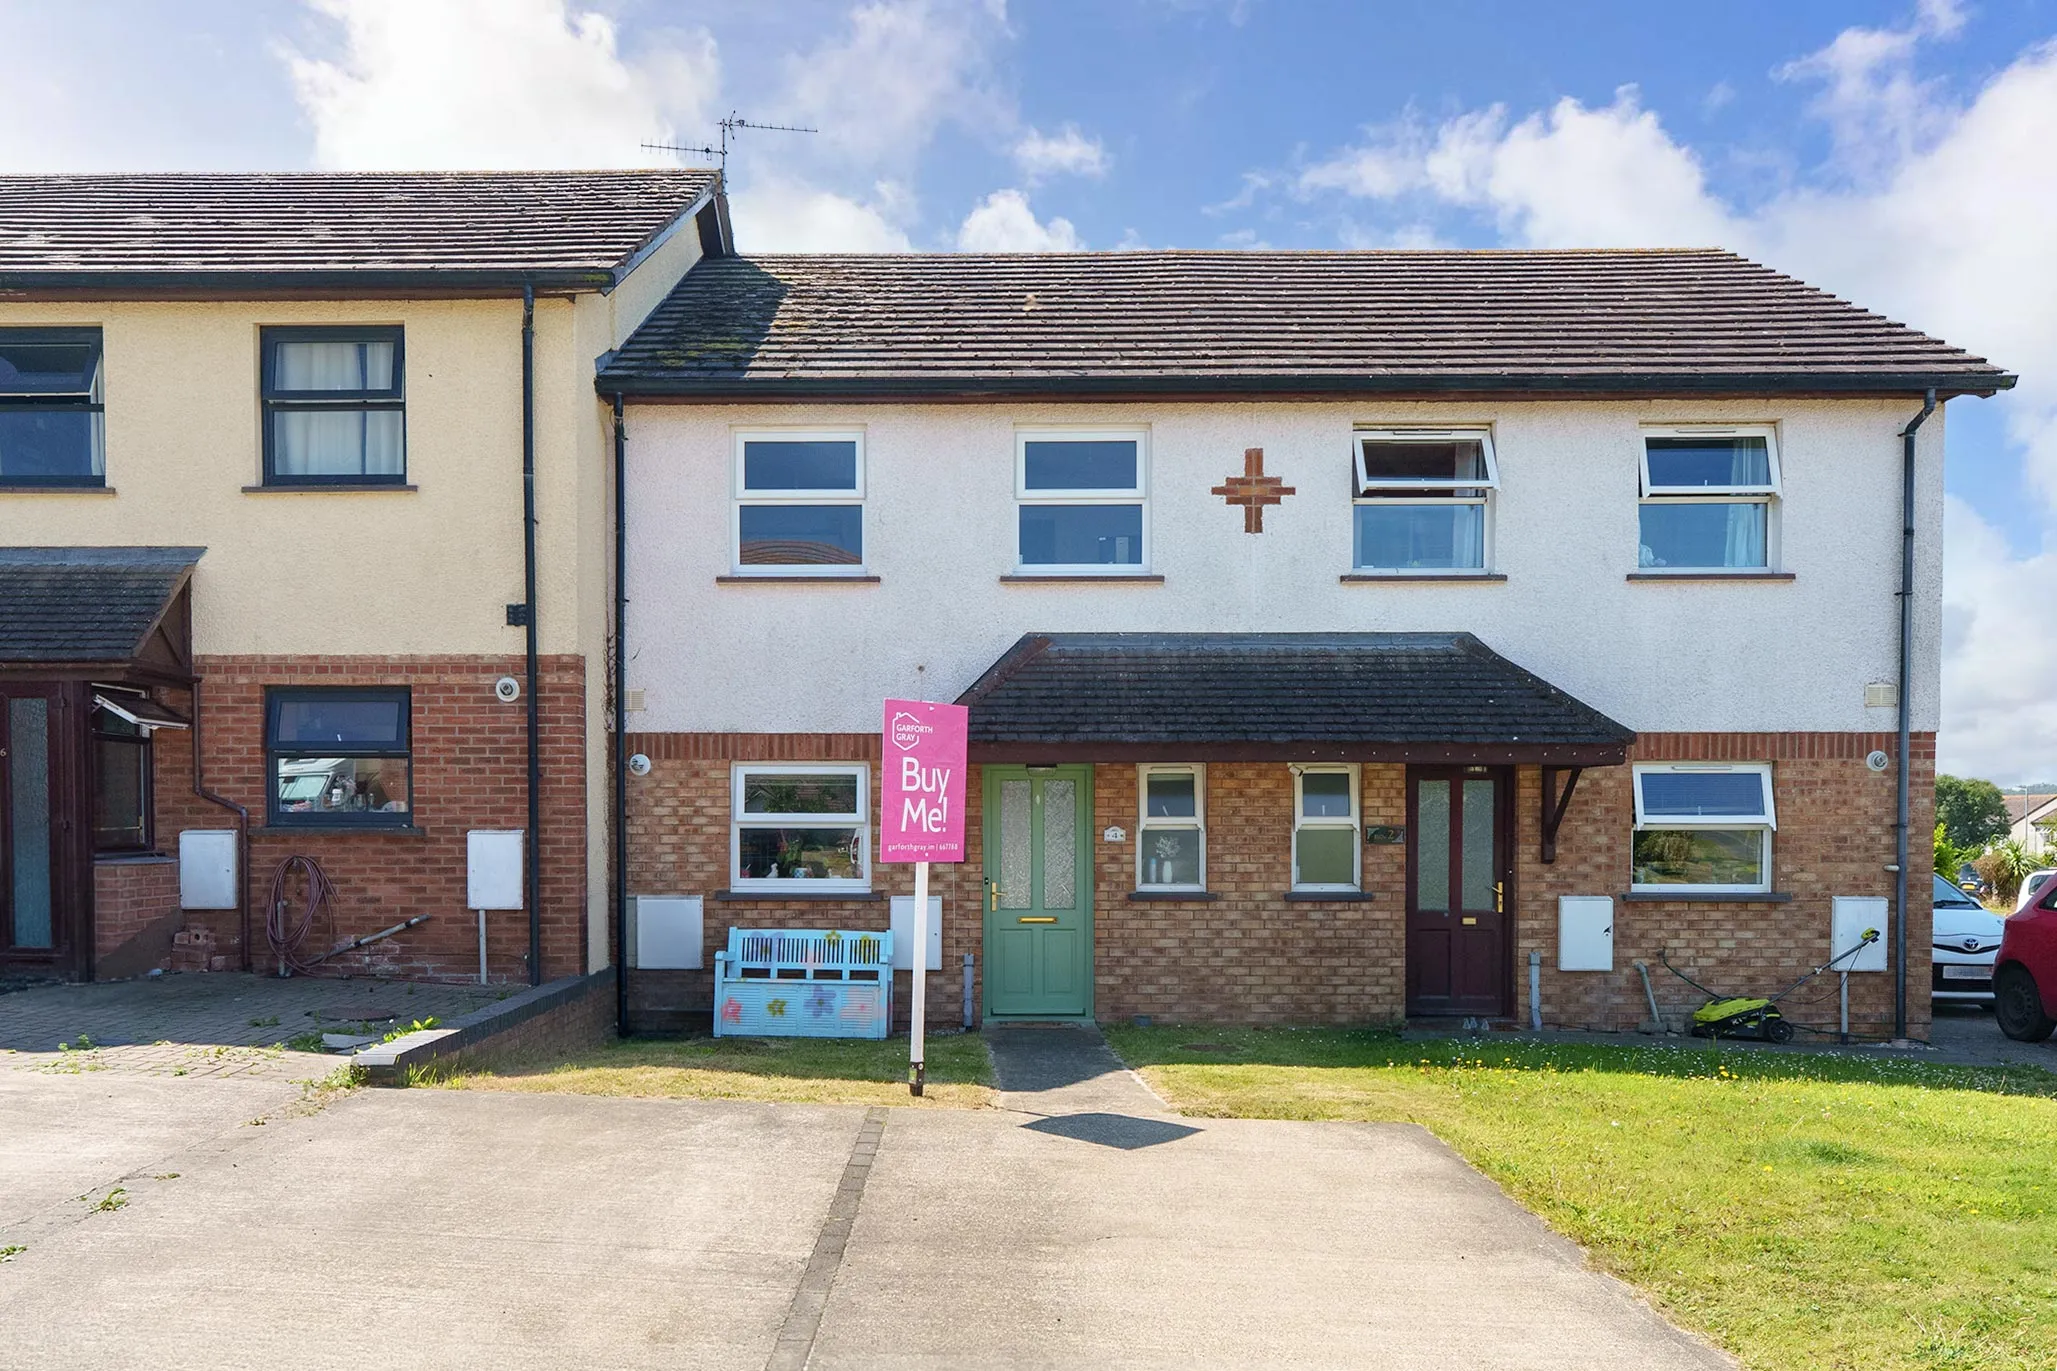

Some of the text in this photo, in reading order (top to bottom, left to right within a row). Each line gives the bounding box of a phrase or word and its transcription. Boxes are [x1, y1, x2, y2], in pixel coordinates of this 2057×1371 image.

[896, 724, 933, 734] GARFORTH
[896, 733, 916, 741] GRAY
[902, 757, 950, 803] Buy
[901, 797, 947, 832] Me!
